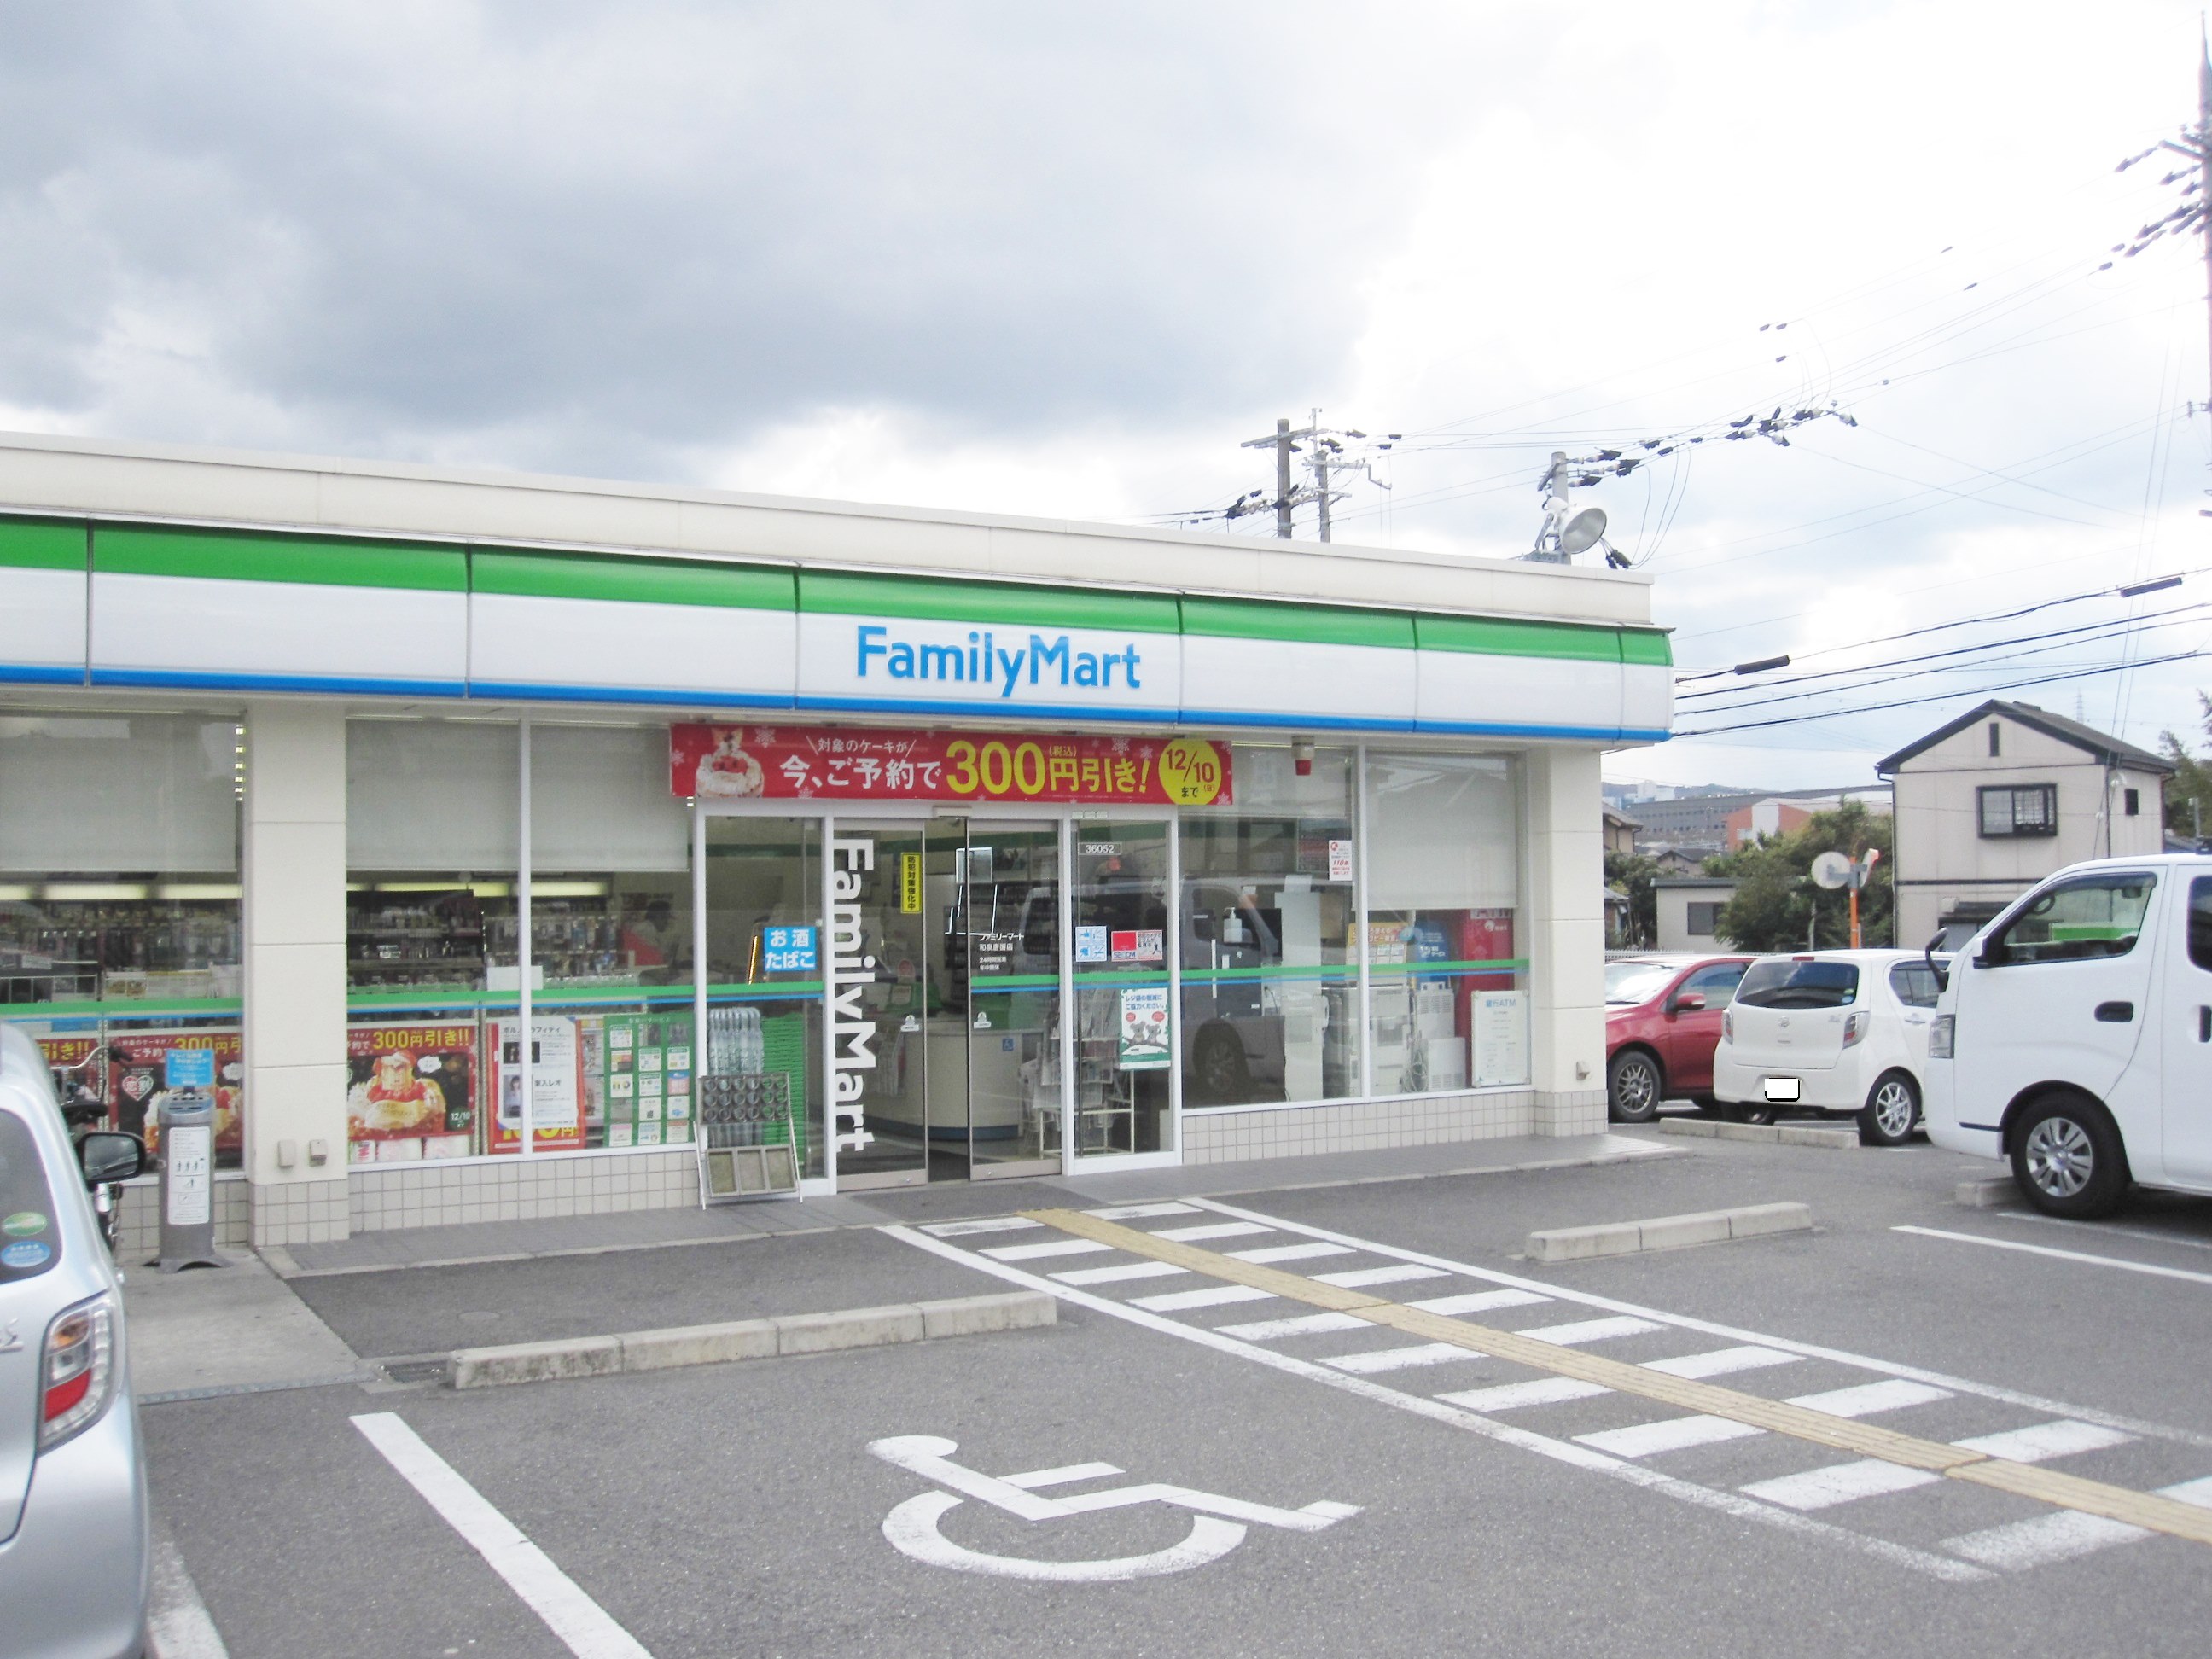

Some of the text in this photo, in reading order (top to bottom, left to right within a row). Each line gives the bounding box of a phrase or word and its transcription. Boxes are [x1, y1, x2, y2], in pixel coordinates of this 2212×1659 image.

[857, 625, 1140, 697] FamilyMart
[818, 737, 908, 754] 対象のケーキが
[1049, 745, 1077, 757] (税込)
[1166, 748, 1214, 783] 12/10
[1181, 786, 1198, 798] まで
[1085, 844, 1115, 853] 36052
[907, 855, 917, 910] 防犯対策強化中
[980, 933, 1024, 941] ファミリーマート
[766, 951, 815, 969] たばこ
[833, 838, 876, 1152] FamilyMart
[450, 1112, 469, 1121] 12/10
